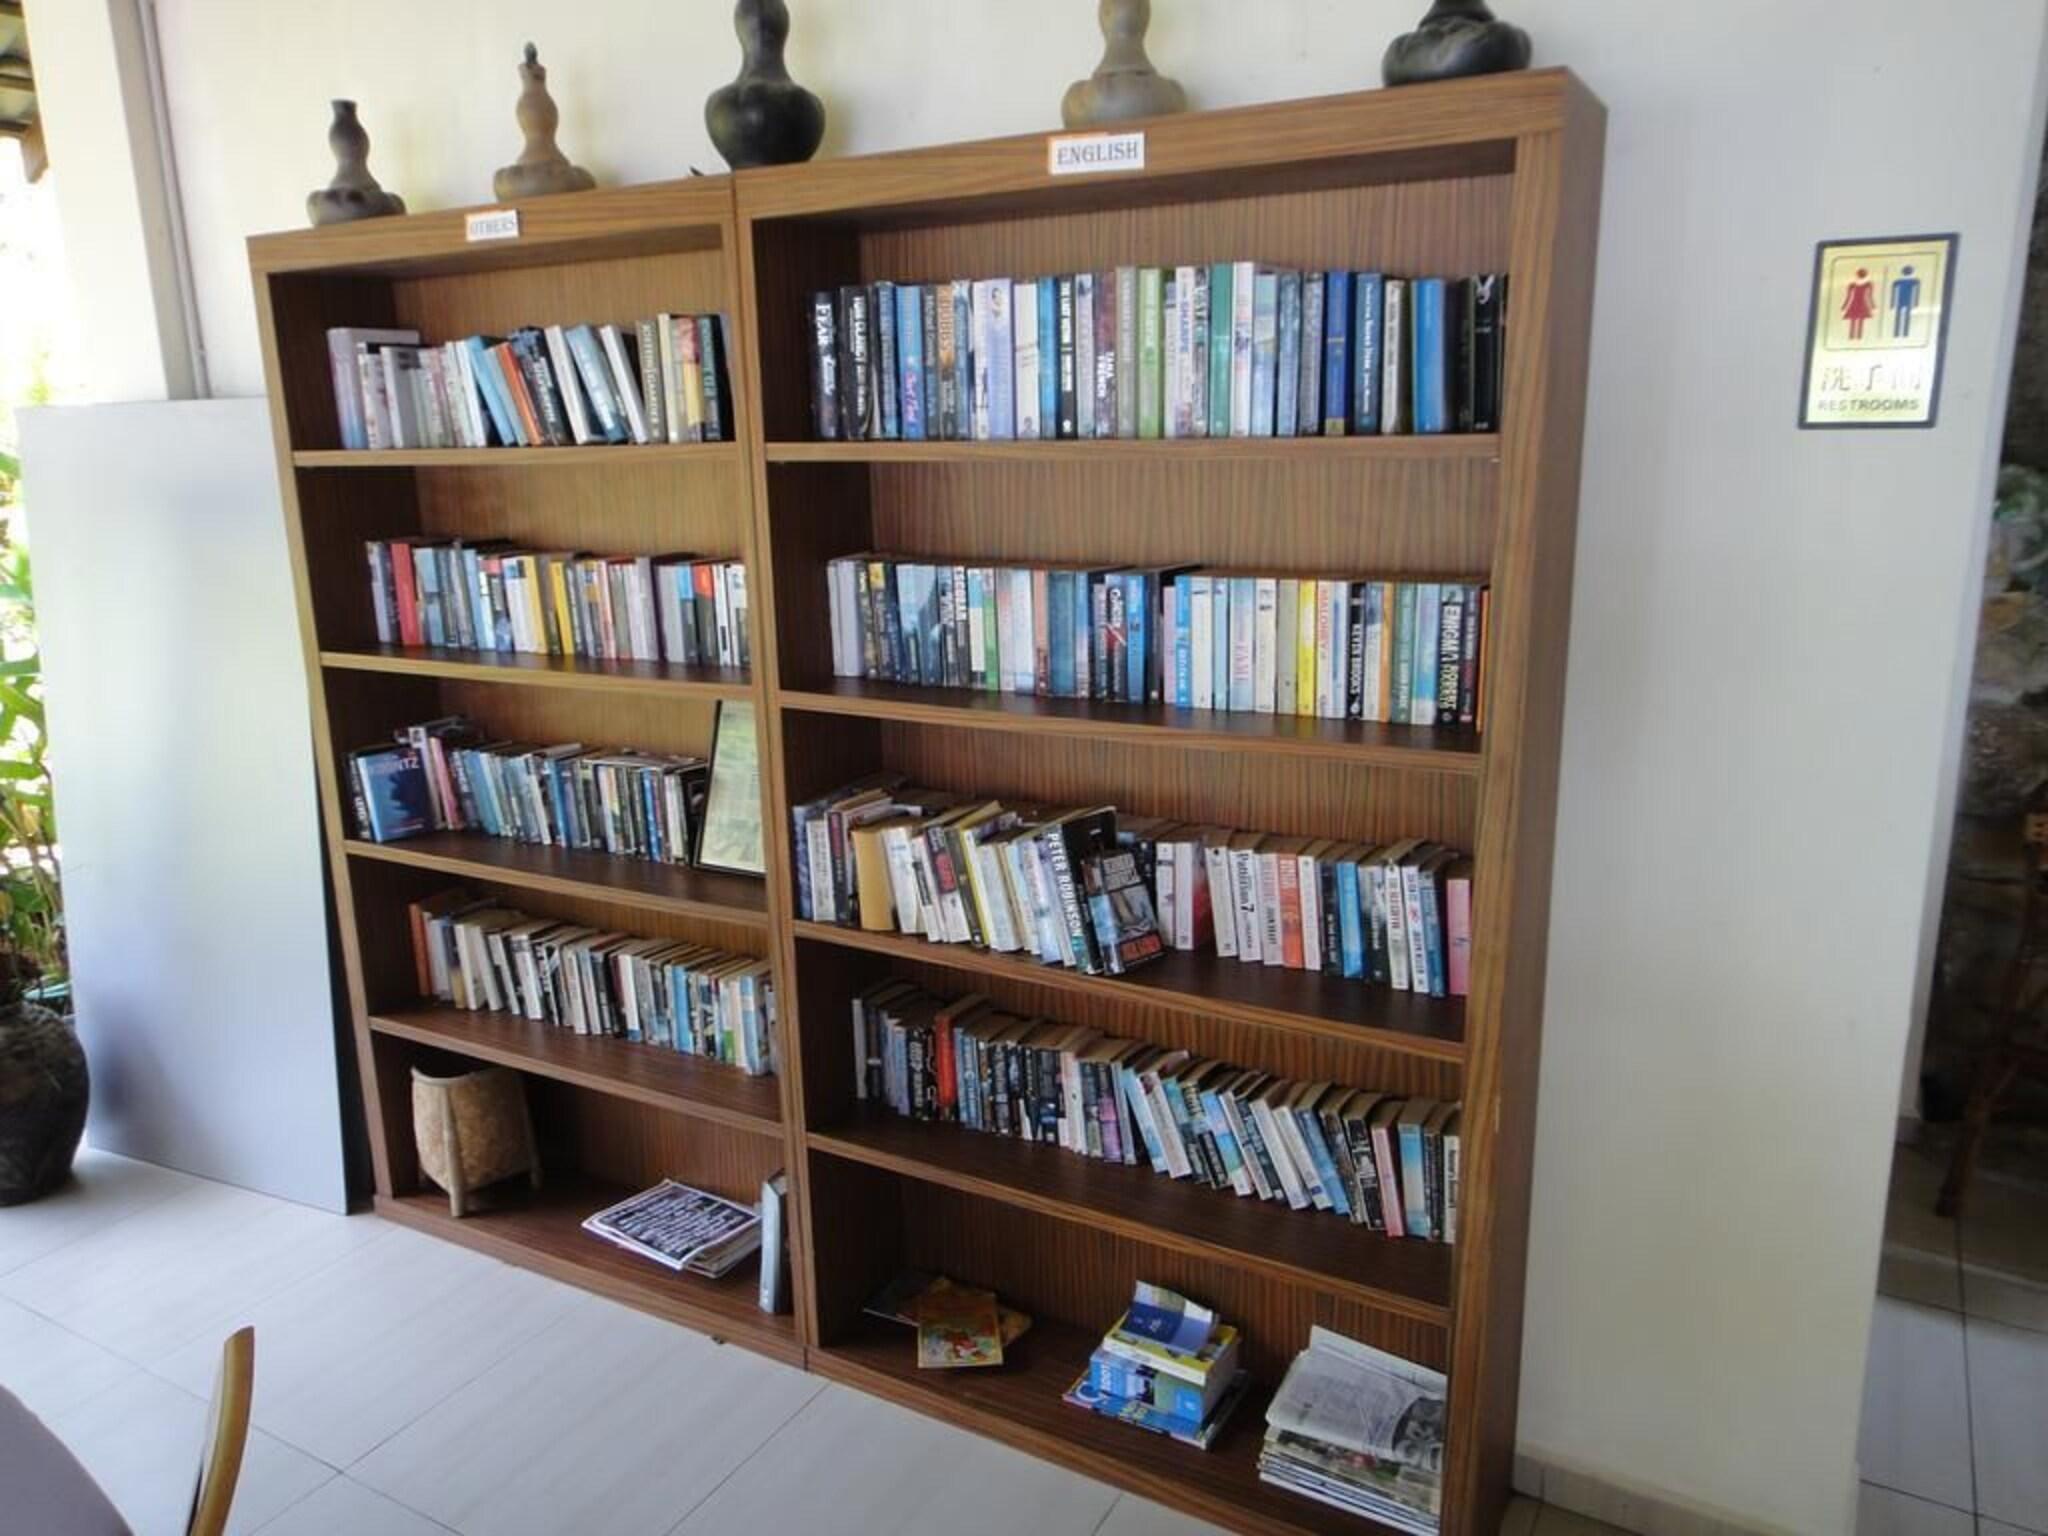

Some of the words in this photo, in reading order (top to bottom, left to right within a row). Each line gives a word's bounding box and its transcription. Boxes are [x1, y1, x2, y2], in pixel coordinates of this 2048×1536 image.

[1057, 140, 1138, 165] ENGLISH
[815, 304, 833, 346] FEAR
[1817, 398, 1920, 412] RESTROOMS
[1440, 605, 1461, 662] ENIGMA
[1047, 832, 1067, 871] PETER
[1058, 875, 1083, 936] ROBINSON
